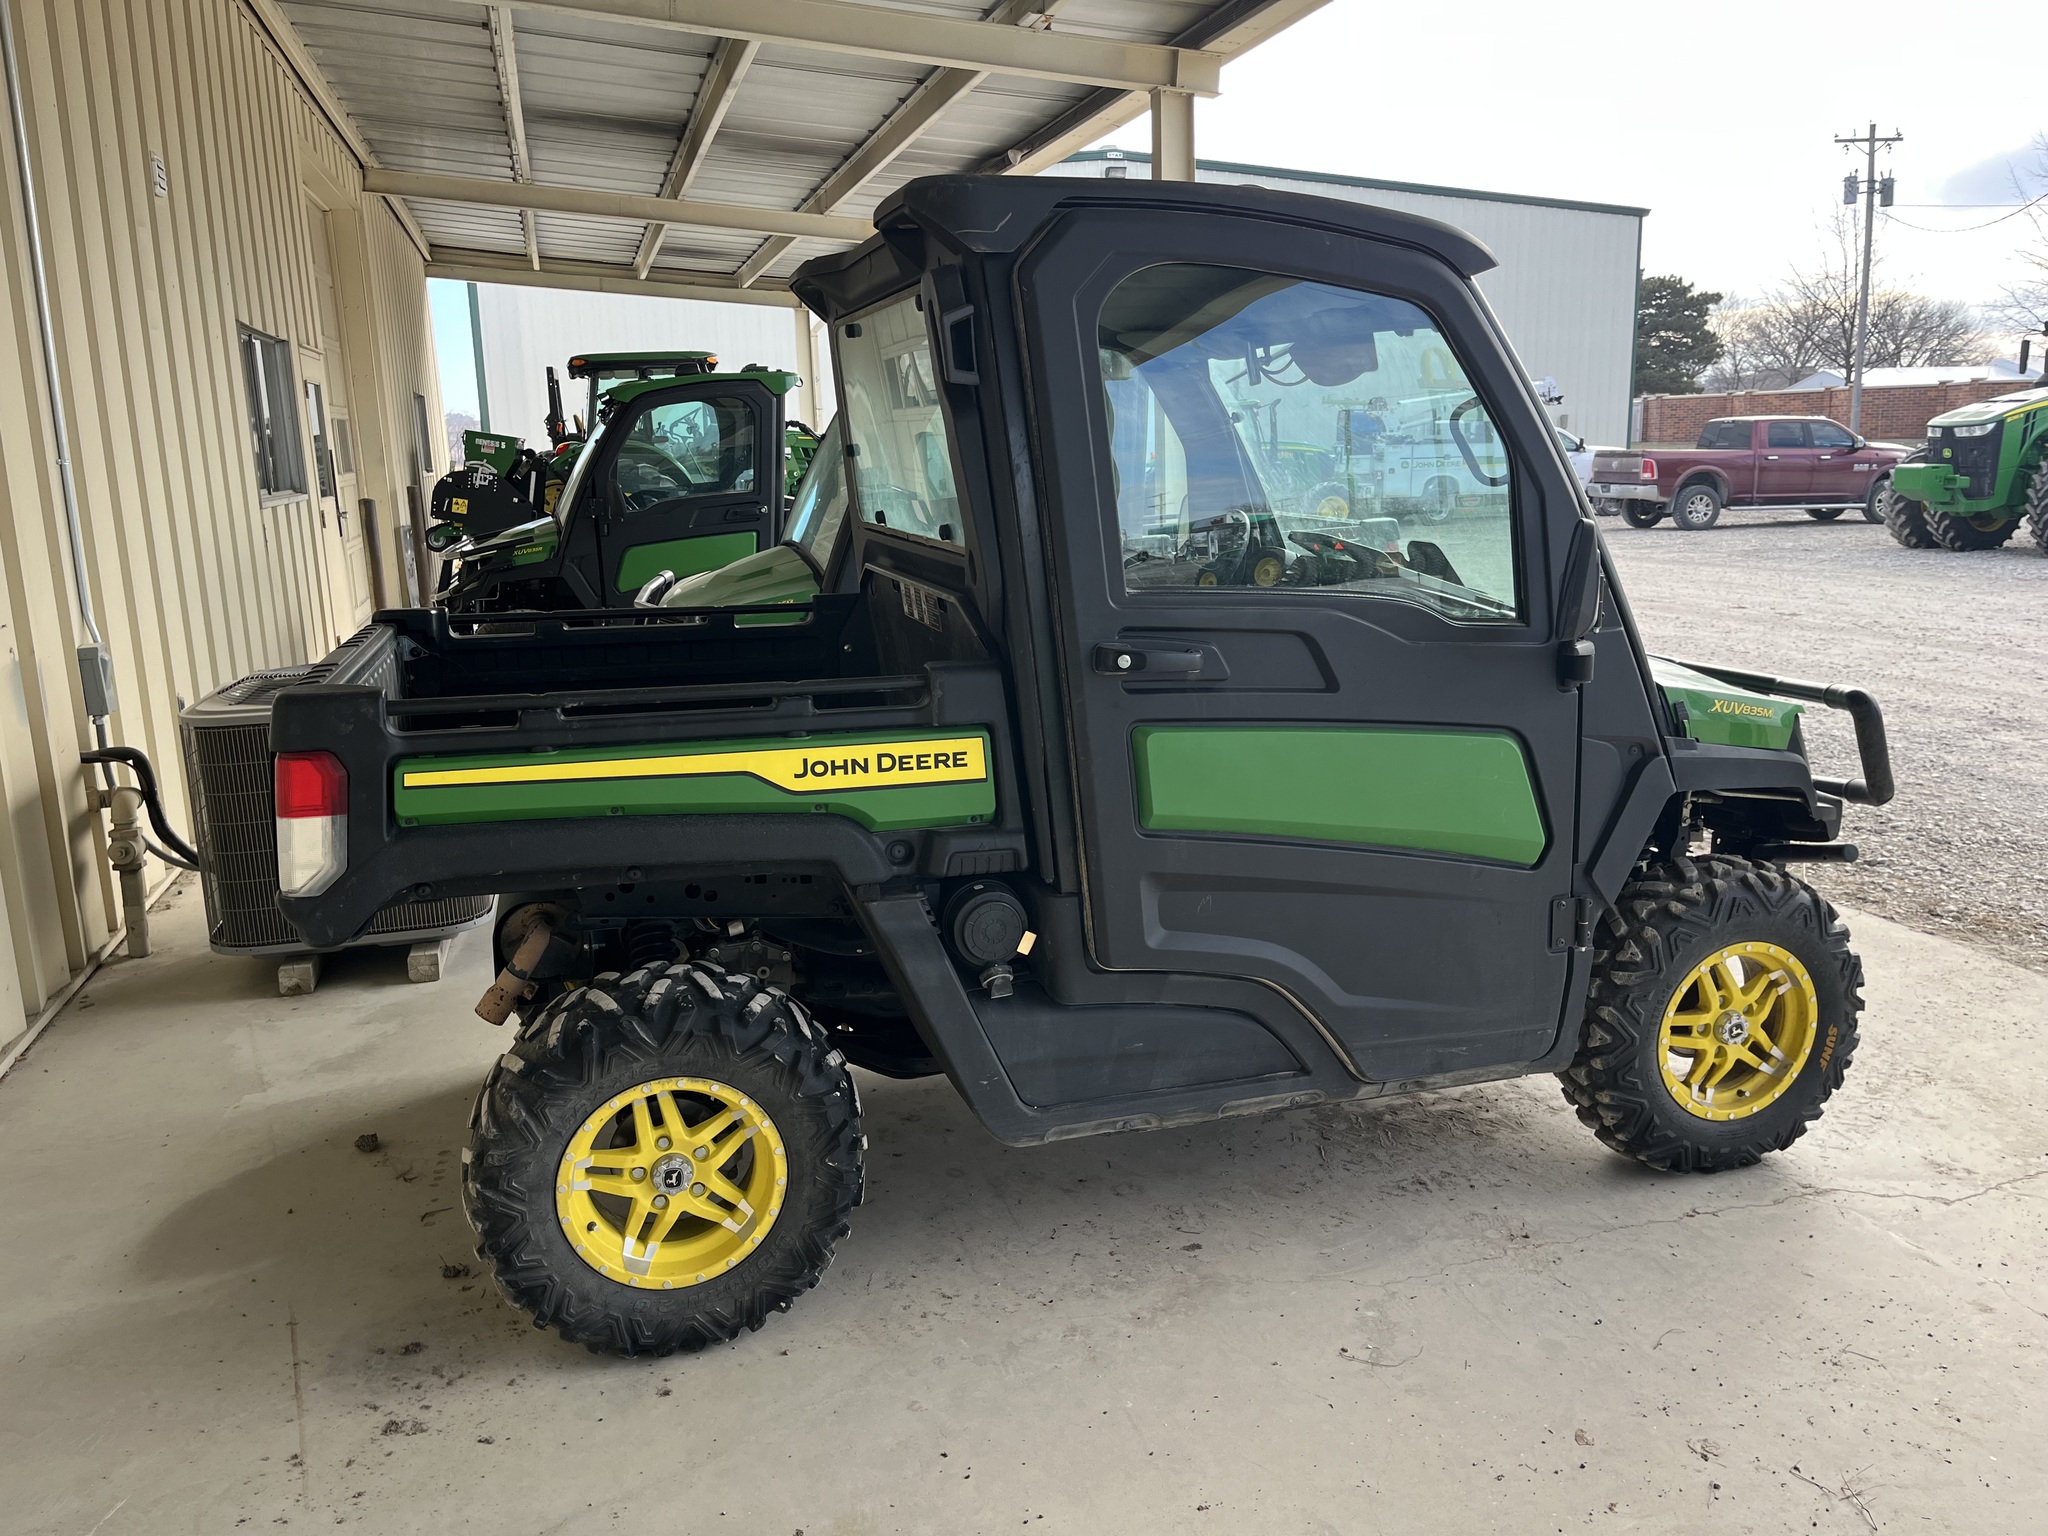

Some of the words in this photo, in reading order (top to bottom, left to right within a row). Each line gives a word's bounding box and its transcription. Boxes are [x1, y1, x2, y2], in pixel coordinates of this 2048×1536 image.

[1711, 699, 1773, 718] XUV835M
[794, 757, 869, 779] JOHN
[876, 751, 968, 773] DEERE
[1820, 1023, 1838, 1073] SUNF
